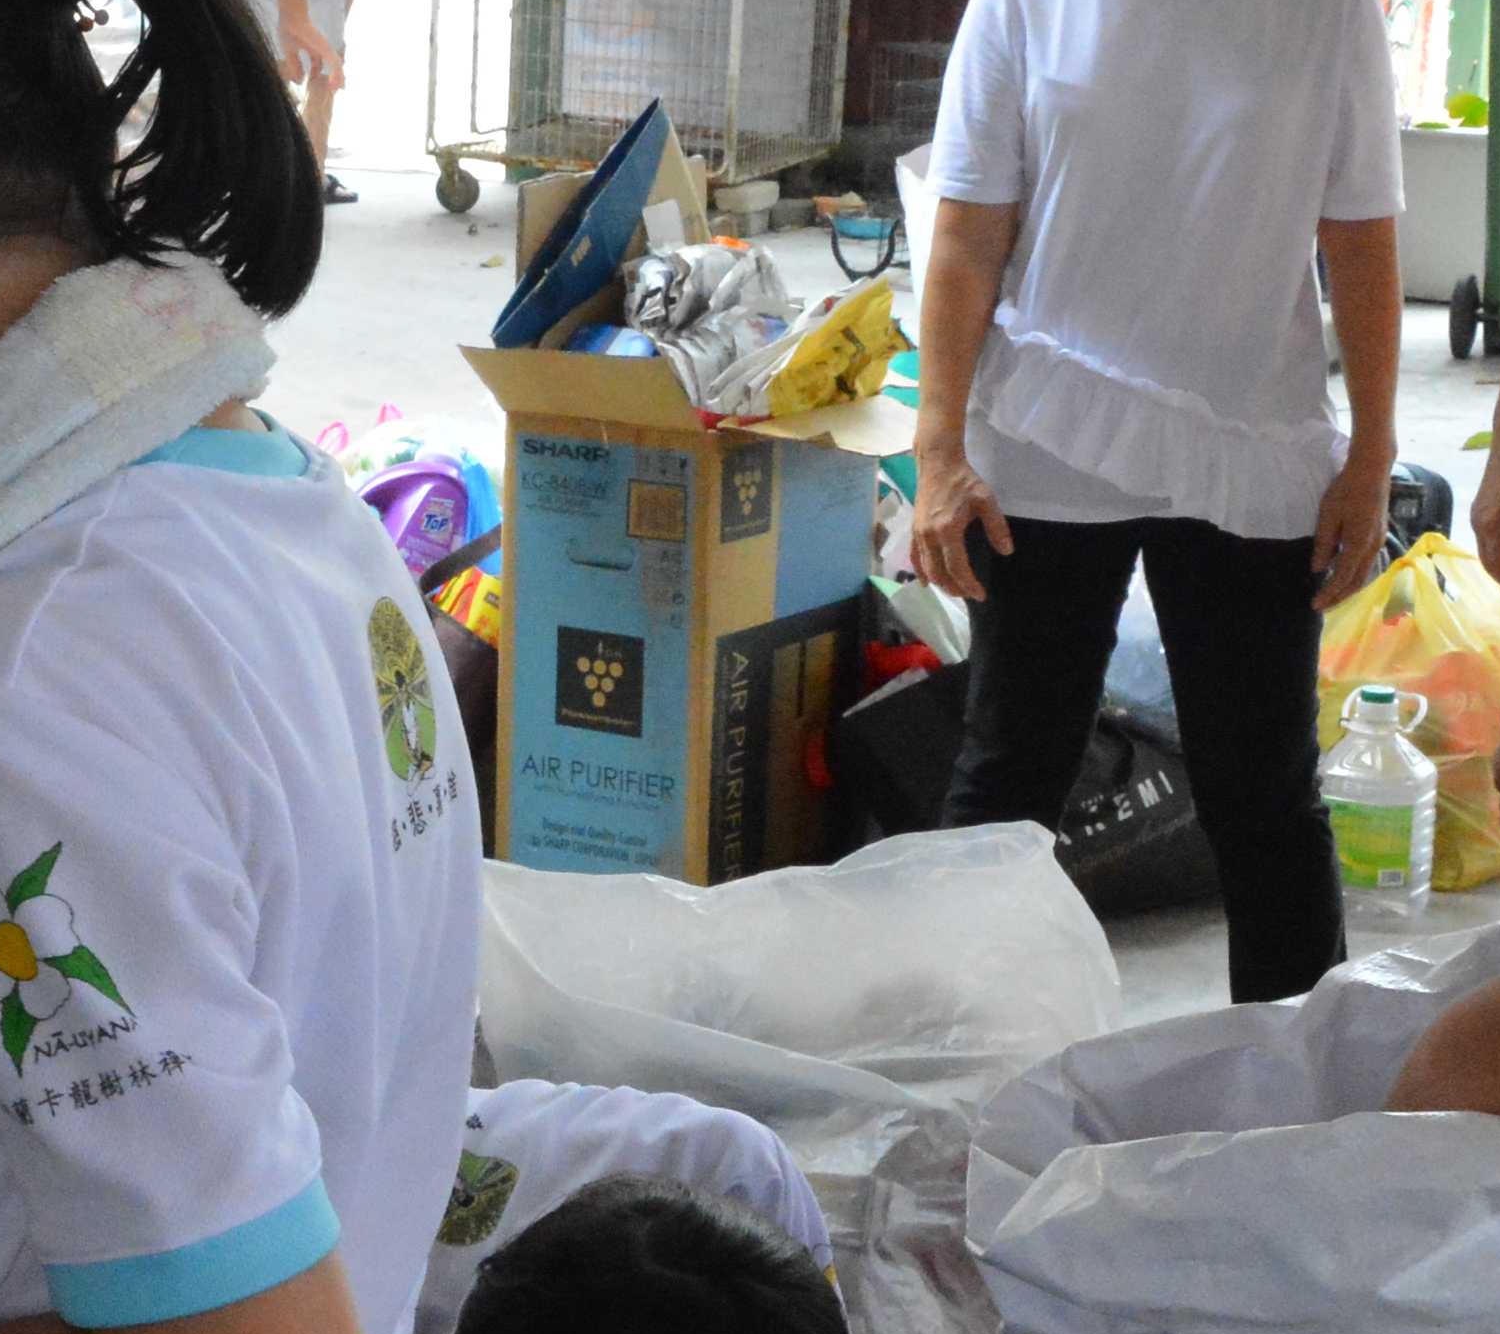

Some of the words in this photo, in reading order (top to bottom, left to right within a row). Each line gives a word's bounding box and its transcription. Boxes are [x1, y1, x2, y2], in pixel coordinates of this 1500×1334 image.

[523, 438, 611, 462] SHARP
[728, 651, 749, 713] AIR
[521, 754, 561, 781] AIR
[570, 761, 676, 799] PURIFIER
